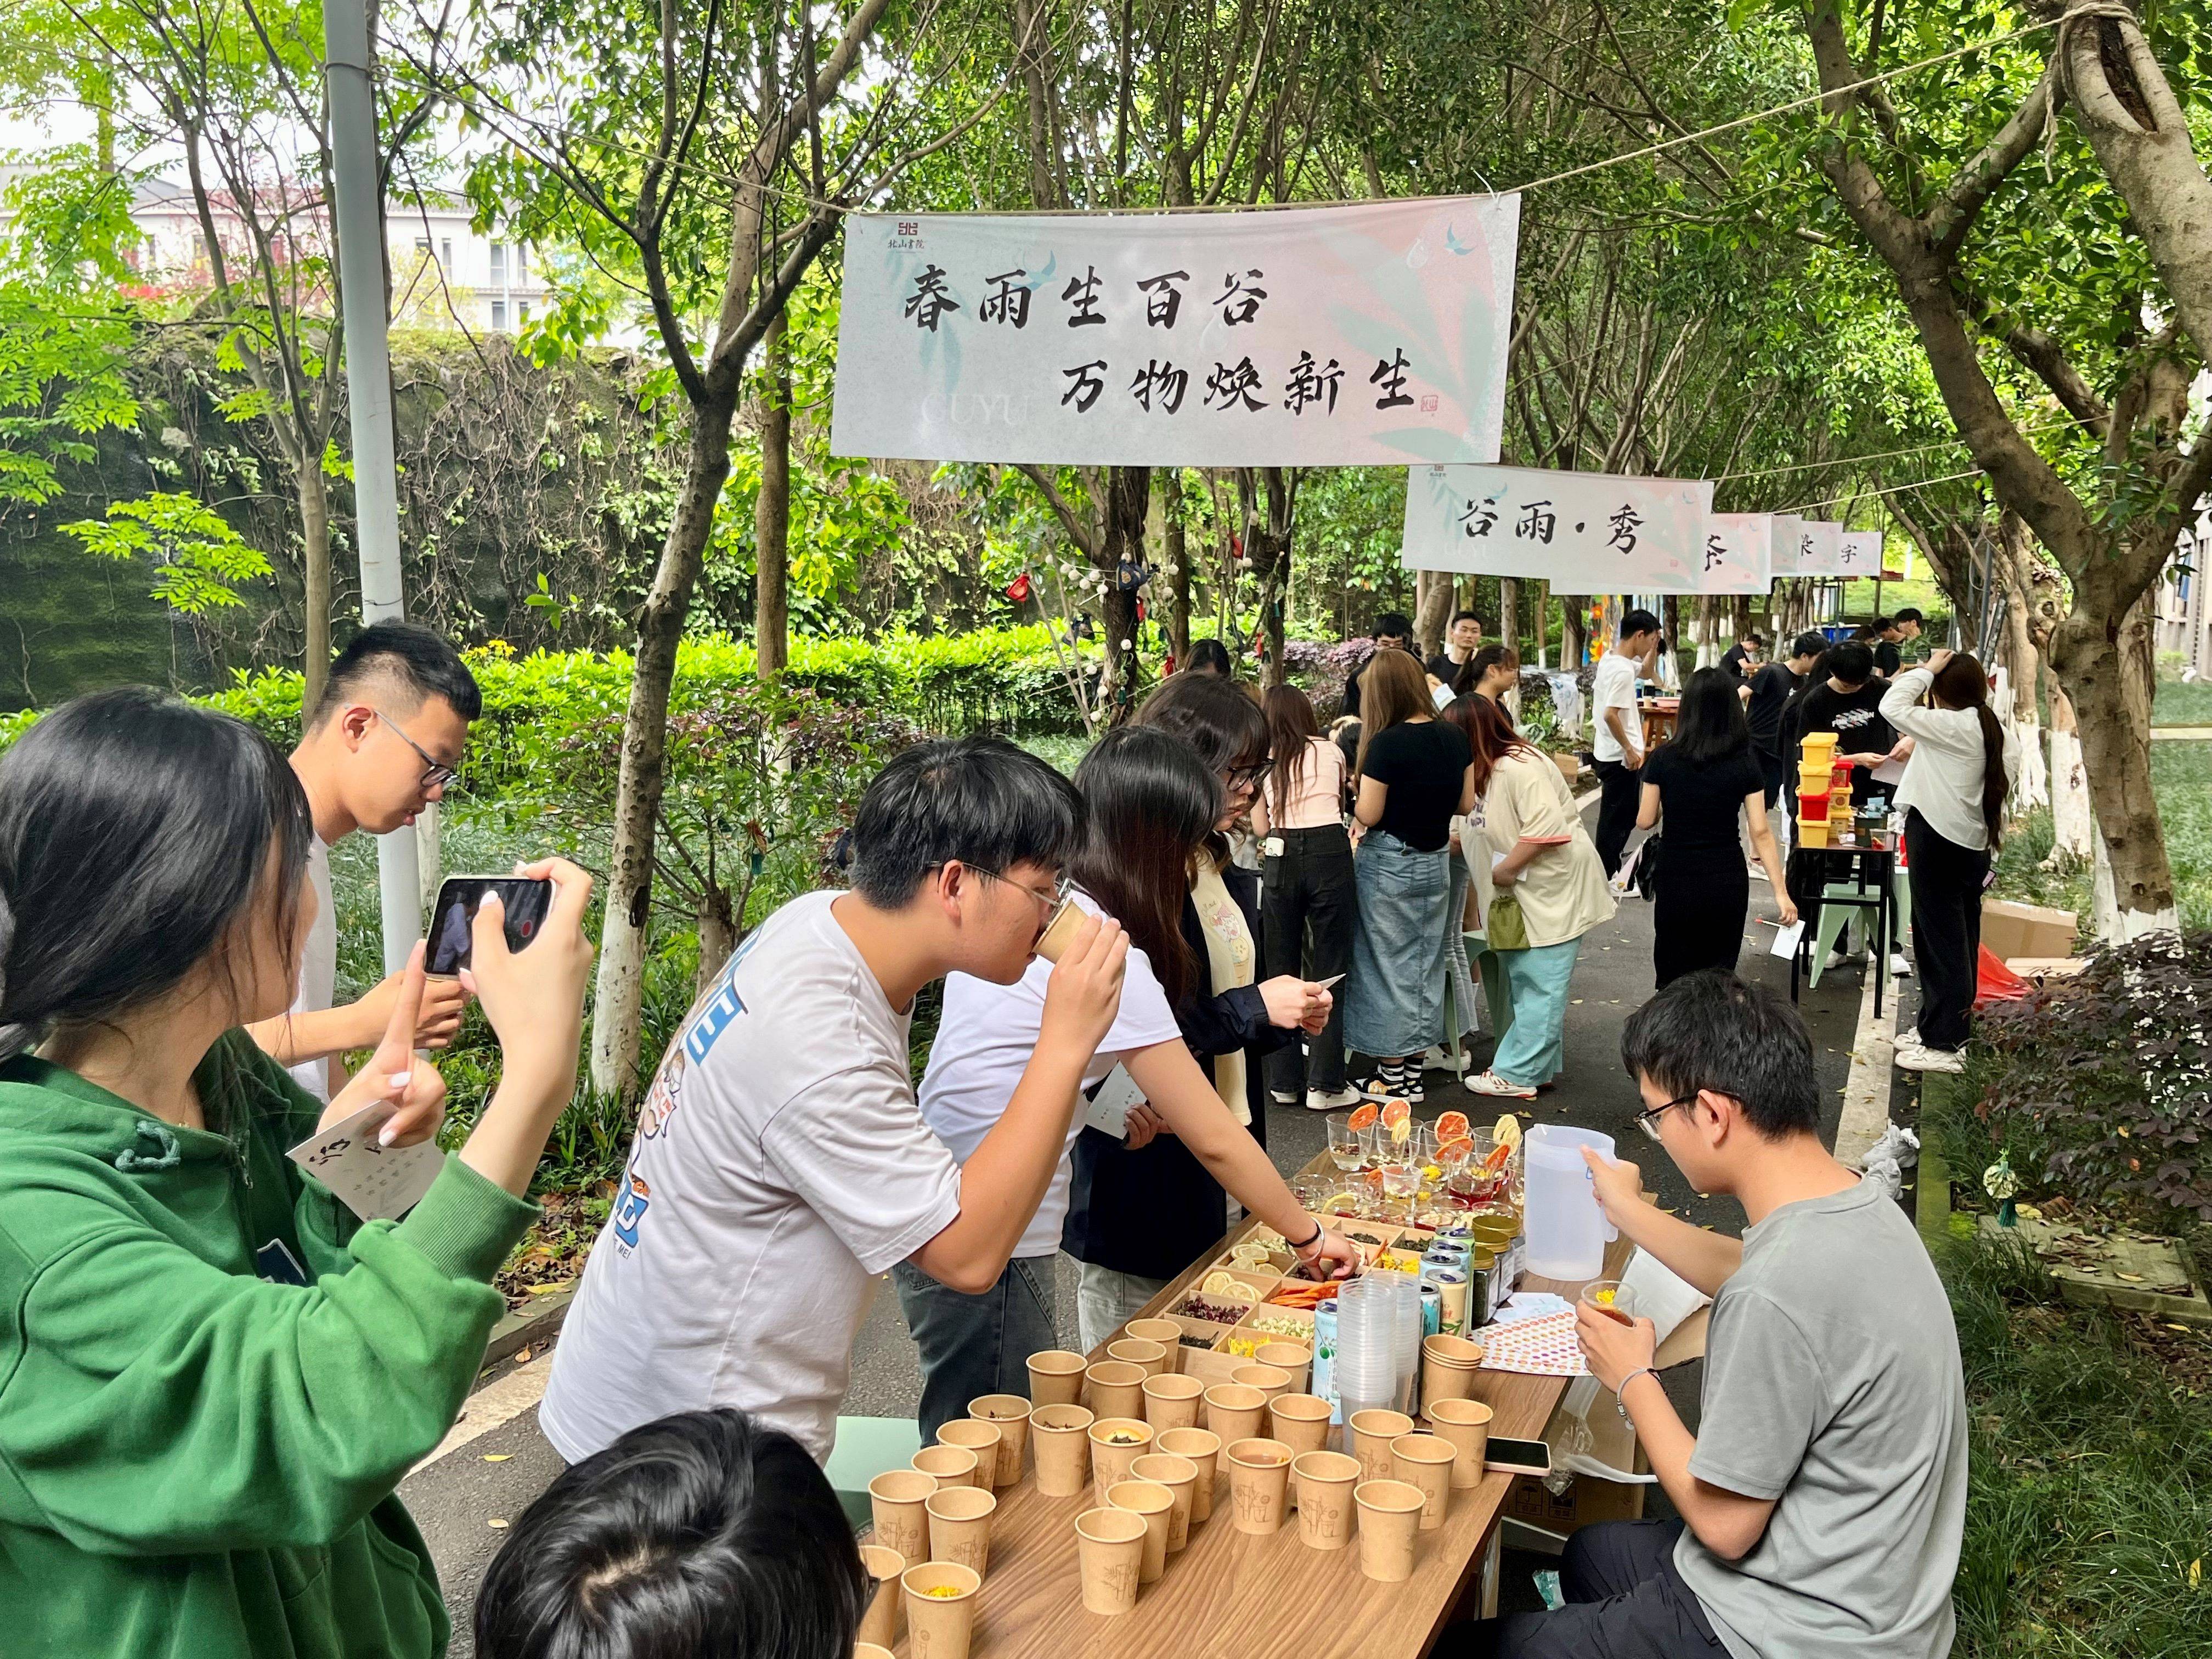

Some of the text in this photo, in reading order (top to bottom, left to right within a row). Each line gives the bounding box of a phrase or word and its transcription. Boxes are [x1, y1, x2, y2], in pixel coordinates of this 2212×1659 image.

[905, 264, 1268, 333] 春雨生百谷
[1061, 347, 1414, 416] 万物焕新生
[1458, 499, 1646, 555] 谷雨·秀
[1841, 544, 1857, 563] 字
